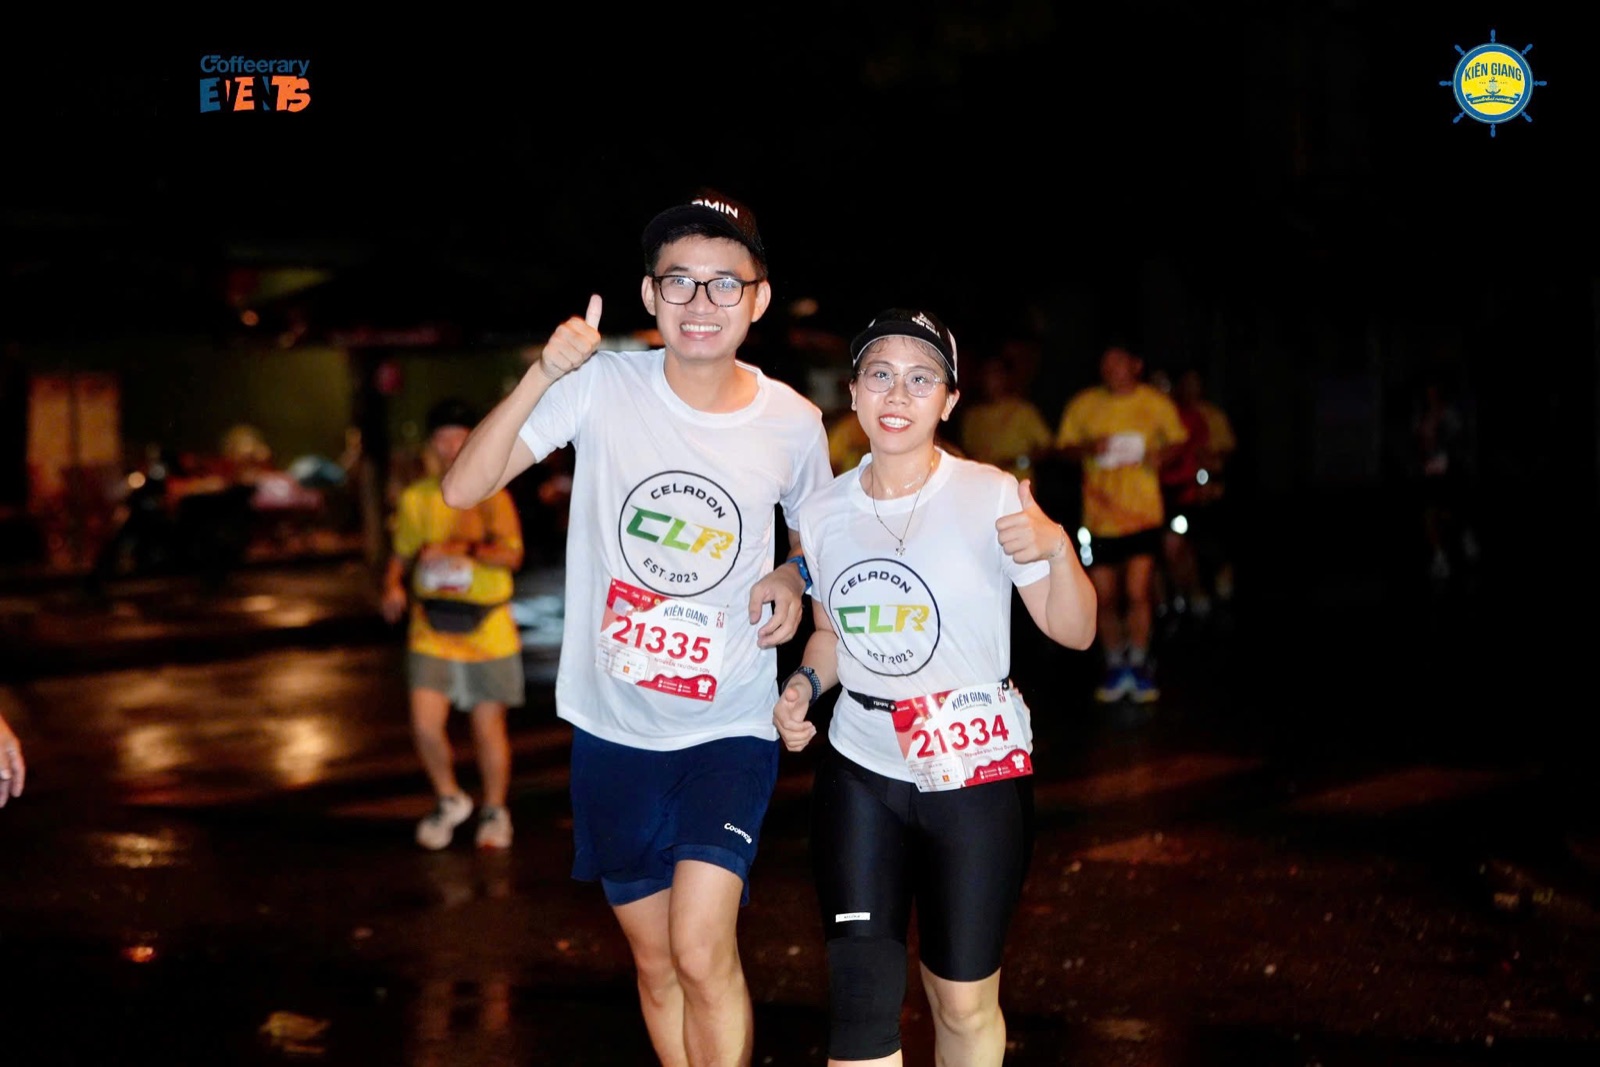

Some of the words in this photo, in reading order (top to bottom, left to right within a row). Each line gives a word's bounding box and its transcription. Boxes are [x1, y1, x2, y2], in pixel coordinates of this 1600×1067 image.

[650, 483, 726, 519] CELADON
[627, 504, 735, 560] CLR
[841, 571, 912, 595] CELADON
[663, 605, 685, 618] KIÊN
[685, 608, 709, 626] GIANG
[716, 611, 725, 621] 21
[833, 604, 930, 634] CLR
[612, 616, 711, 665] 21335
[952, 693, 970, 711] KIÊN
[970, 691, 993, 705] GIANG
[912, 714, 1009, 759] 21334
